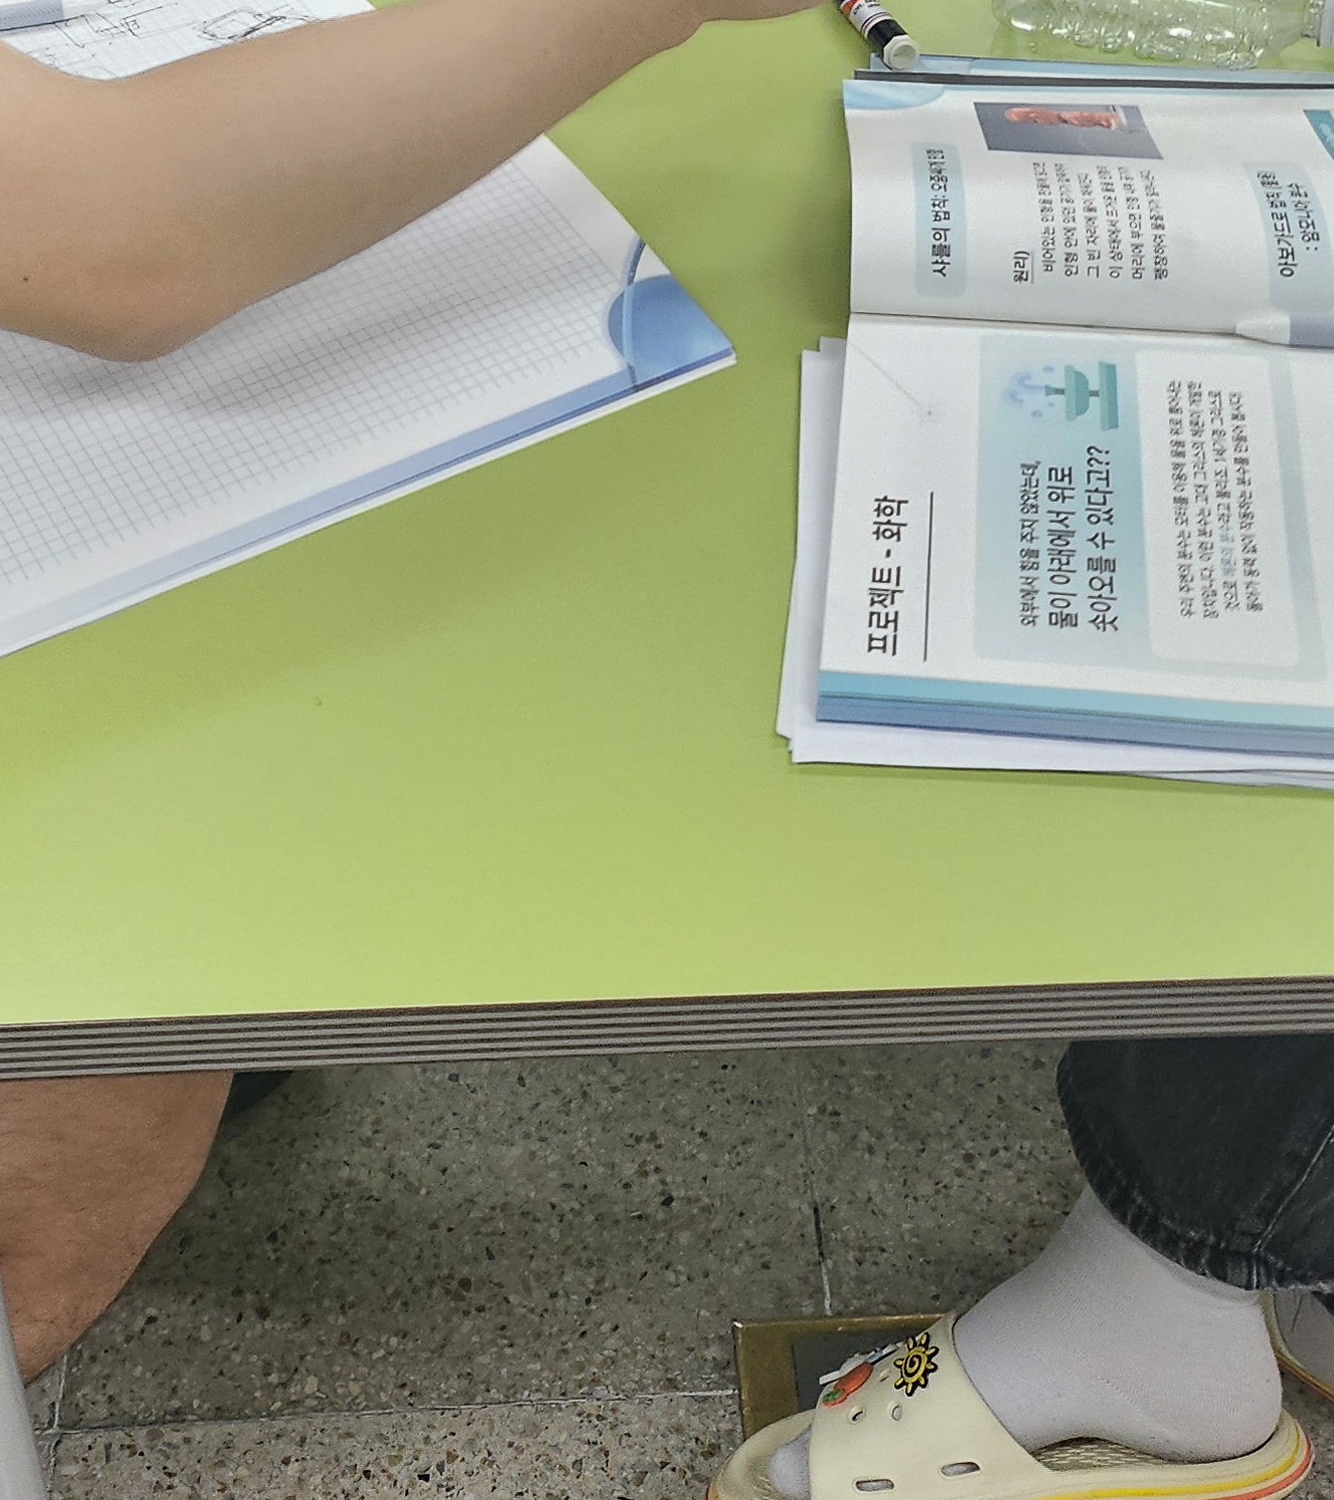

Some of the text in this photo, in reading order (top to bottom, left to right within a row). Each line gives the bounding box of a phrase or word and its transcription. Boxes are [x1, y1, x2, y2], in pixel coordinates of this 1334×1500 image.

[930, 194, 950, 222] 법칙:
[1102, 195, 1118, 217] 뜨거운
[1286, 182, 1320, 243] 암모니아 분수
[1062, 227, 1078, 248] 안에
[1083, 216, 1099, 246] 자리에
[1106, 220, 1123, 262] 상태에서
[1127, 213, 1143, 240] 부으면
[930, 228, 951, 278] 샤를의
[1041, 226, 1056, 273] 비어있는
[1085, 249, 1101, 261] 빈
[1130, 243, 1146, 280] 머리에
[1151, 234, 1168, 281] 팽창하여
[1271, 212, 1298, 278] 아보가드로
[1012, 250, 1030, 284] 원리)
[1063, 252, 1079, 277] 인형
[1086, 266, 1100, 278] 그
[1108, 266, 1123, 279] 이
[1191, 440, 1207, 481] 그리스의
[1194, 483, 1209, 505] 고대
[1086, 446, 1119, 633] 솟아오를 수 있다고??
[1196, 507, 1213, 538] 분수는
[1019, 460, 1041, 627] 외부에서 힘을 주지 않았는데,
[1047, 466, 1078, 629] 물이 아래에서 위로
[1176, 529, 1192, 560] 분수는
[867, 495, 909, 657] 프로젝트 화학
